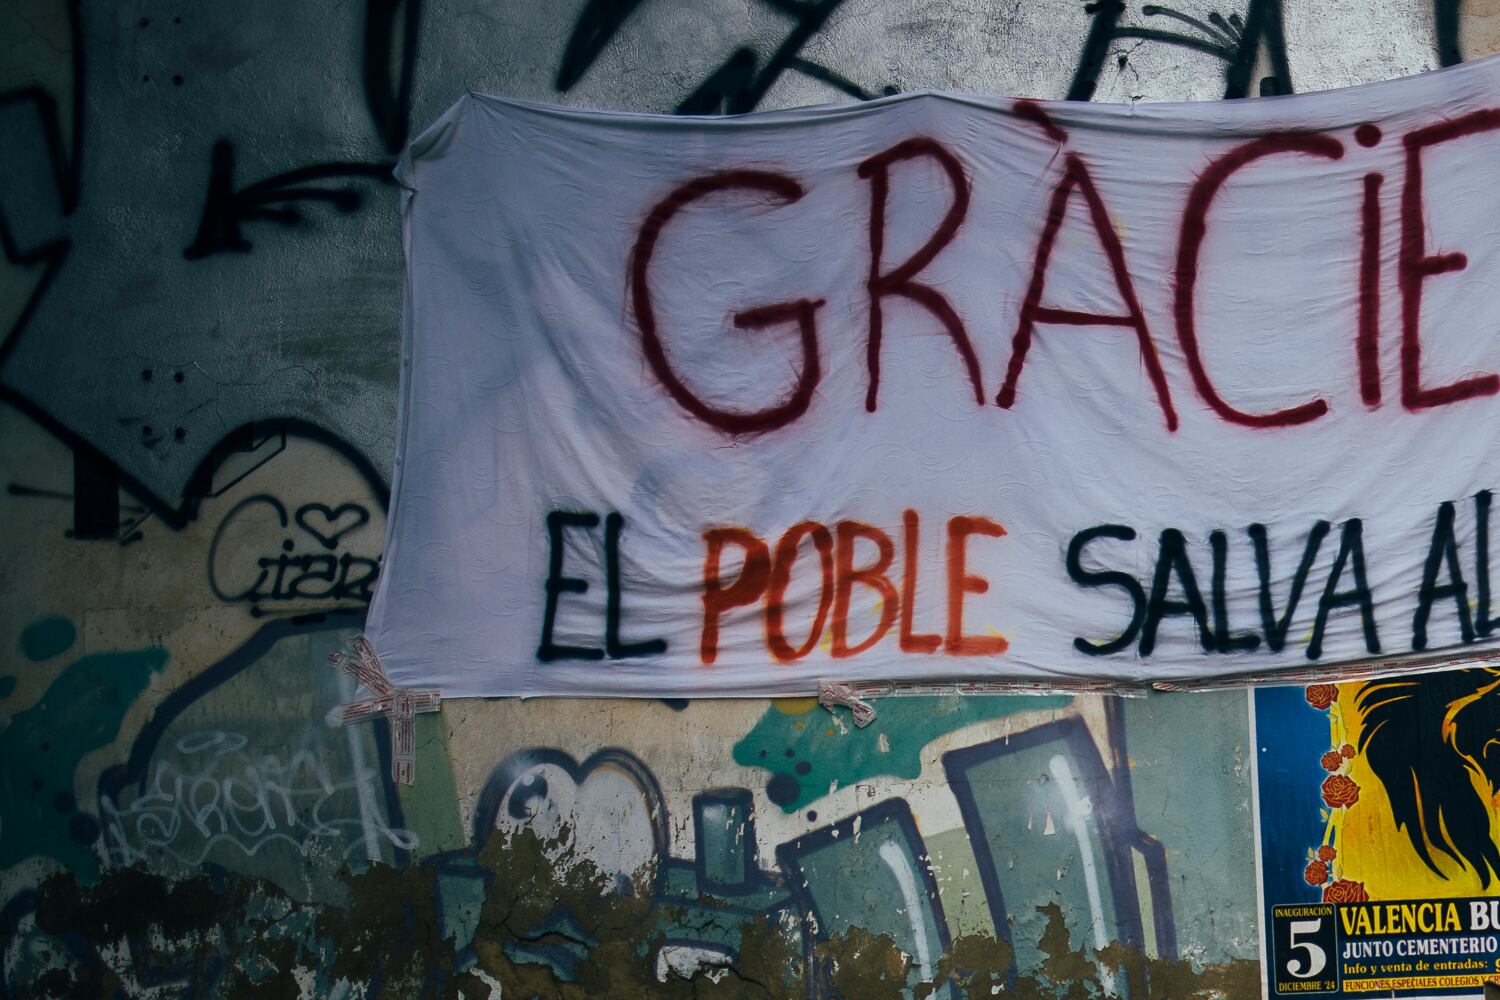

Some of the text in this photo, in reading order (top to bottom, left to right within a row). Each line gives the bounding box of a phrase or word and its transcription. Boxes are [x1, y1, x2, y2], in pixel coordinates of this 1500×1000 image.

[536, 511, 669, 662] EL
[700, 508, 1011, 666] POBLE
[1064, 517, 1382, 661] SALVA
[1340, 902, 1462, 936] VALENCIA
[1286, 917, 1327, 979] 5
[1342, 940, 1394, 959] JUNTO
[1396, 936, 1498, 957] CEMENTERIO
[1343, 957, 1489, 975] Info y venta de entradas:
[1279, 982, 1323, 992] DICIEMBRE
[1345, 979, 1390, 991] FUNCIONES
[1392, 978, 1438, 989] ESPECIALES
[1438, 975, 1480, 987] COLEGIOS
